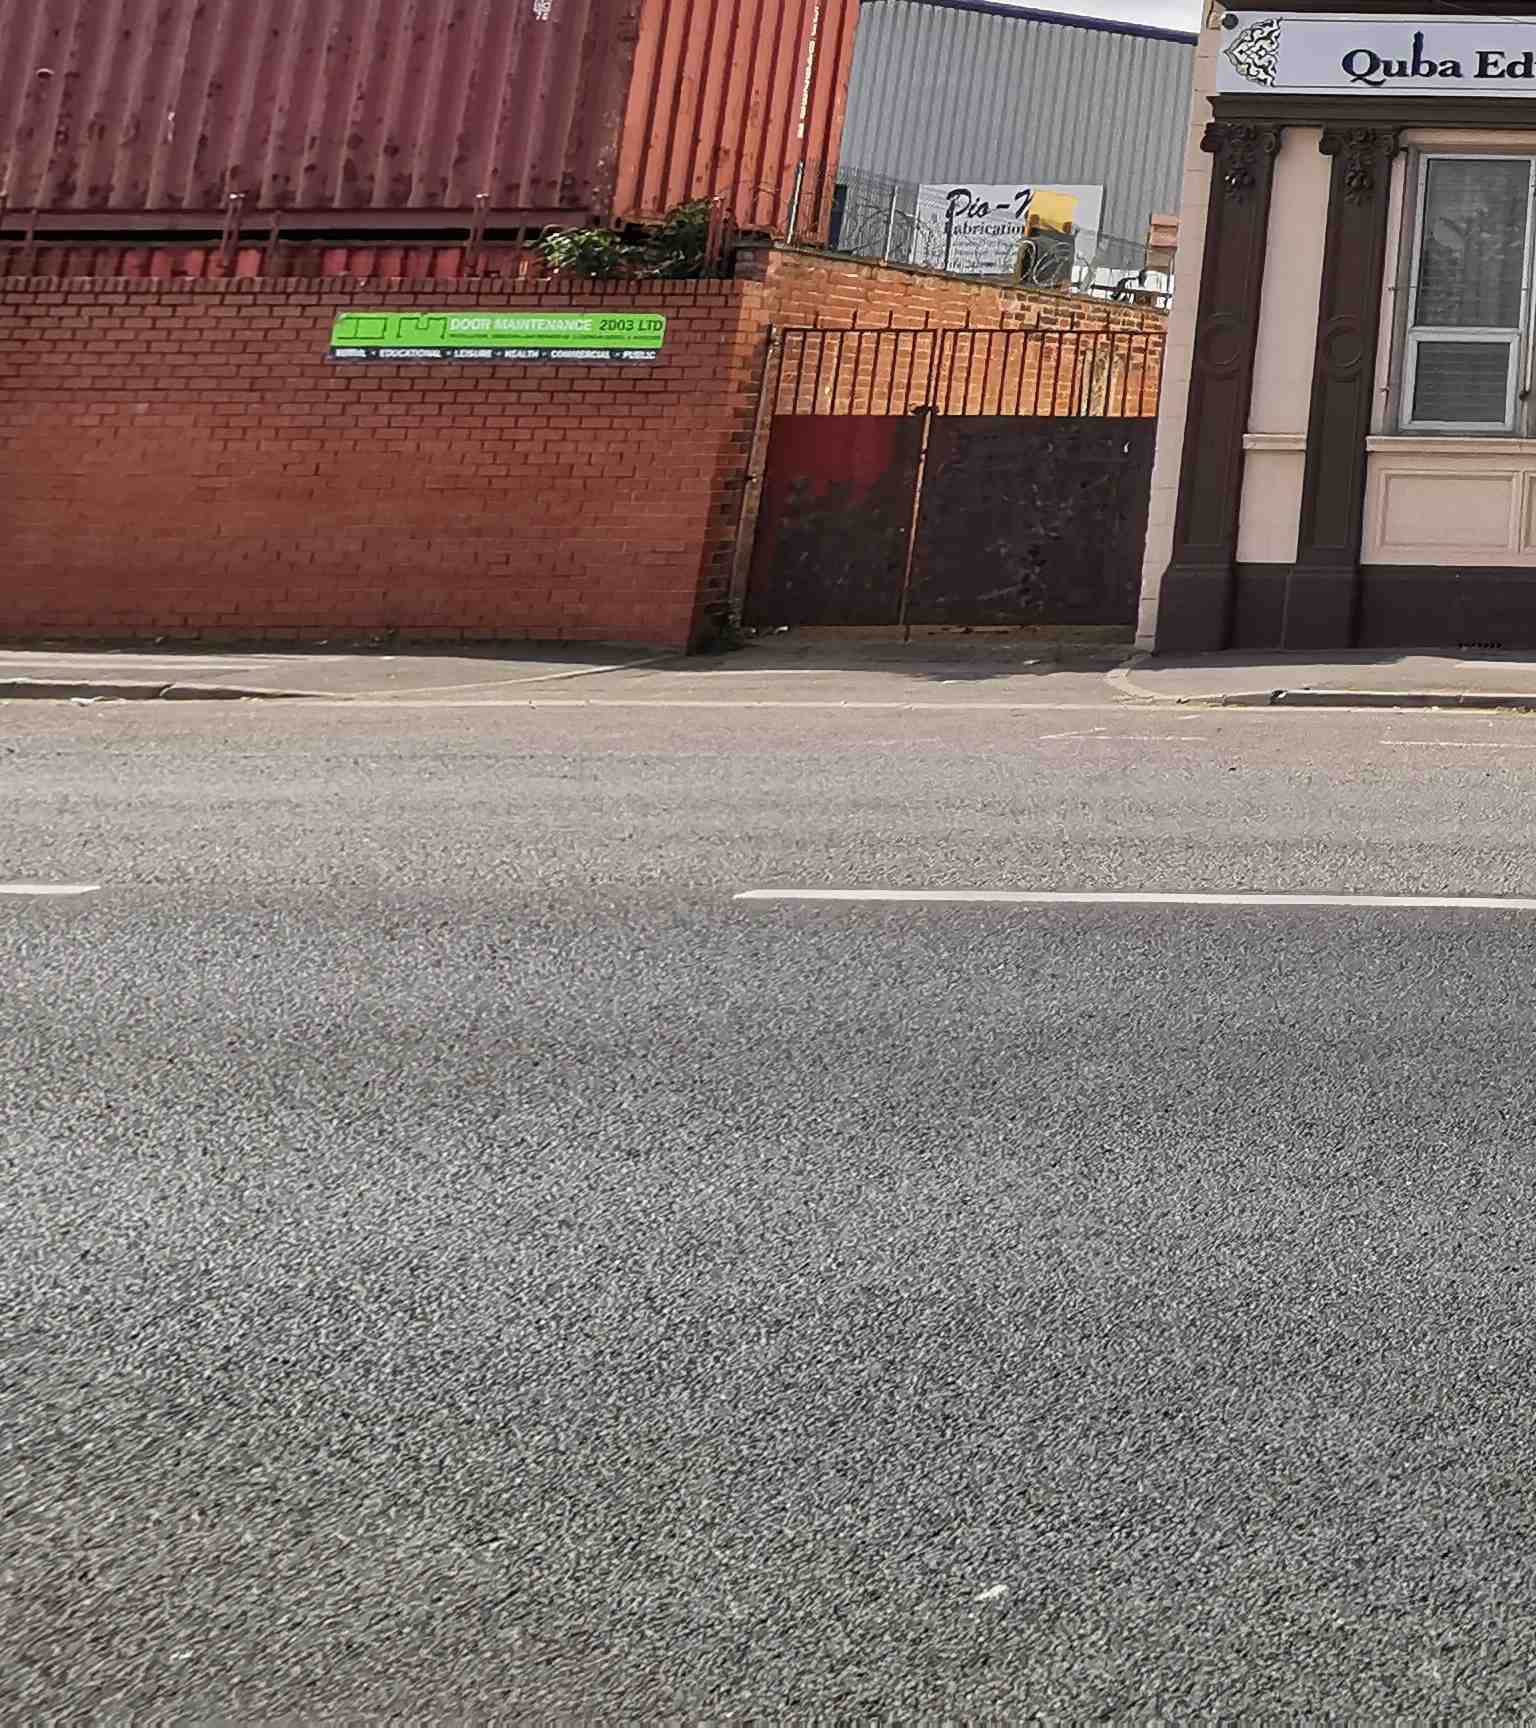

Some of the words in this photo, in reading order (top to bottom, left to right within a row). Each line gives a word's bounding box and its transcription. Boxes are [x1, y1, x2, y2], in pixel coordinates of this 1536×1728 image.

[1341, 31, 1463, 85] Quba
[450, 319, 490, 332] DOOR
[495, 319, 592, 332] MAINTENANCE
[599, 319, 634, 332] 2003
[638, 319, 663, 332] LTD
